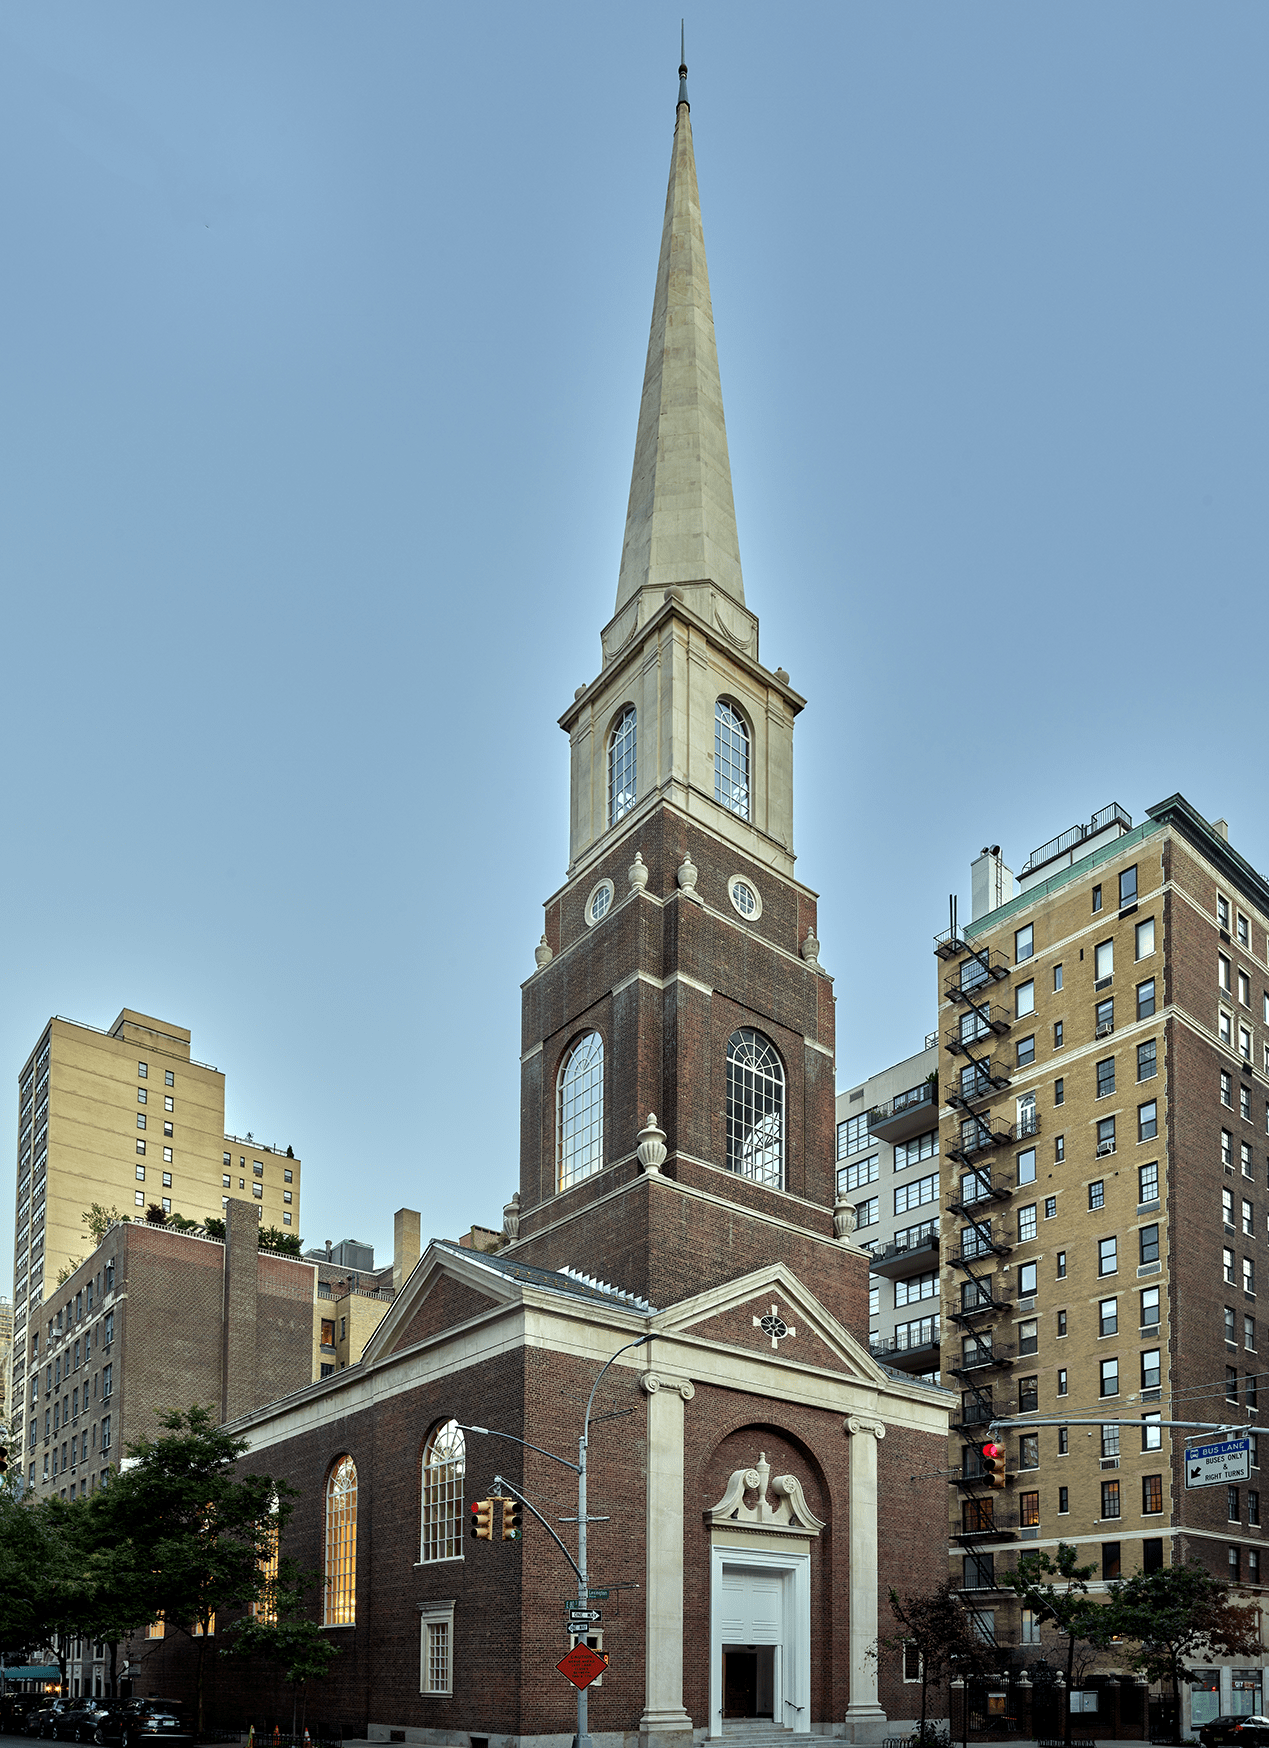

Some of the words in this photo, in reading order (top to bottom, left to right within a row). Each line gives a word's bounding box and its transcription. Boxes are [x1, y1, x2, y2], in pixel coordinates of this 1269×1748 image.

[1202, 1447, 1219, 1456] BUS
[1221, 1442, 1245, 1452] LANE
[1205, 1456, 1225, 1465] BUSES
[1227, 1452, 1244, 1461] ONLY
[1204, 1472, 1222, 1482] RIGHT
[1225, 1469, 1245, 1478] TURNS
